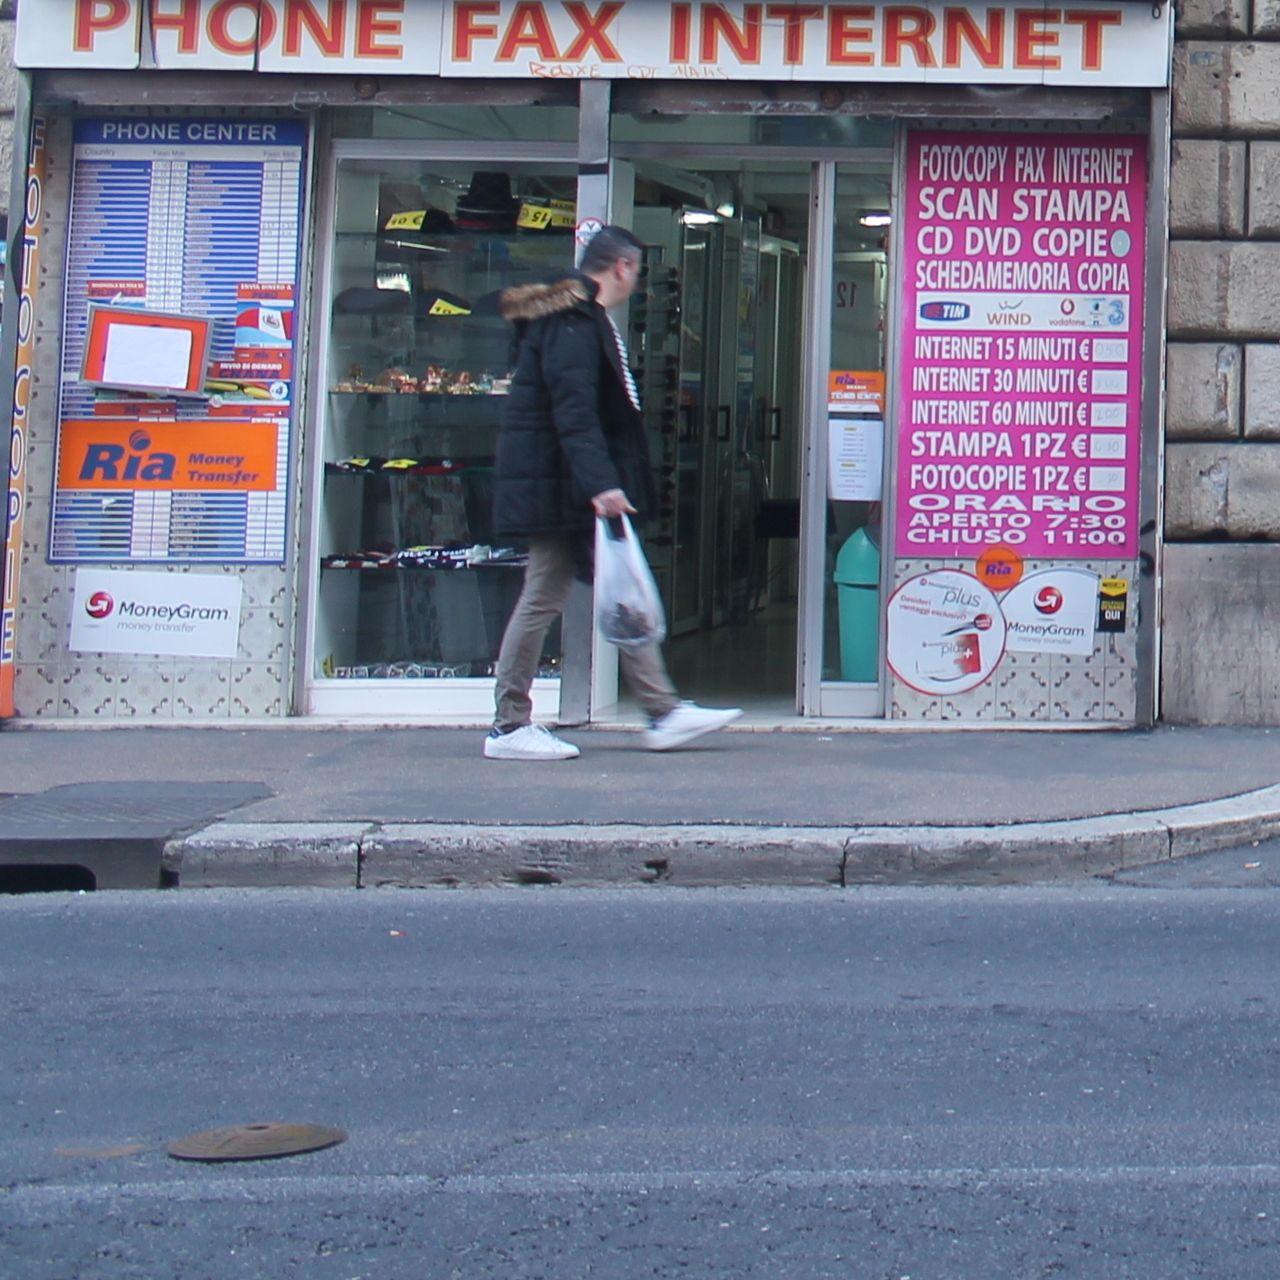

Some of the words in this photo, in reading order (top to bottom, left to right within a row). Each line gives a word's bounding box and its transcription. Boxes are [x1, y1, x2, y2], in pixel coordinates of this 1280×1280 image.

[452, 0, 626, 64] FAX
[668, 1, 1122, 72] INTERNET
[102, 123, 181, 140] PHONE
[187, 124, 277, 141] CENTER
[919, 144, 1008, 182] FOTOCOPY
[1014, 146, 1045, 183] FAX
[1053, 148, 1133, 184] INTERNET
[918, 187, 998, 221] SCAN
[1012, 188, 1131, 222] STAMPA
[917, 226, 953, 255] CD
[965, 227, 1021, 256] DVD
[1032, 227, 1107, 257] COPIE
[915, 260, 1070, 290] SCHEDAMEMORIA
[1077, 262, 1130, 291] COPIA
[943, 305, 965, 318] TIM
[986, 313, 1032, 325] WIND
[915, 336, 993, 360] INTERNET
[996, 337, 1014, 360] 15
[1018, 337, 1076, 361] MINUTI
[1079, 339, 1090, 361] €
[913, 367, 991, 392] INTERNET
[993, 368, 1013, 392] 30
[1016, 368, 1074, 393] MINUTI
[1077, 370, 1088, 394] €
[912, 399, 990, 425] INTERNET
[992, 400, 1012, 426] 60
[1015, 401, 1073, 426] MINUTI
[1076, 402, 1087, 427] €
[79, 429, 177, 481] Ria
[911, 431, 1013, 458] STAMPA
[1071, 434, 1087, 459] €
[188, 453, 244, 468] Money
[187, 471, 259, 485] Transfer
[910, 464, 1026, 490] FOTOCOPIE
[1073, 467, 1087, 491] €
[909, 513, 1031, 528] APERTO
[1046, 514, 1126, 529] 7:30
[906, 528, 1027, 544] CHIUSO
[1043, 530, 1126, 545] 11:00
[942, 587, 980, 607] plus
[118, 600, 229, 621] MoneyGram
[117, 622, 153, 632] money
[154, 621, 197, 633] transfer
[1008, 622, 1085, 637] MoneyGram
